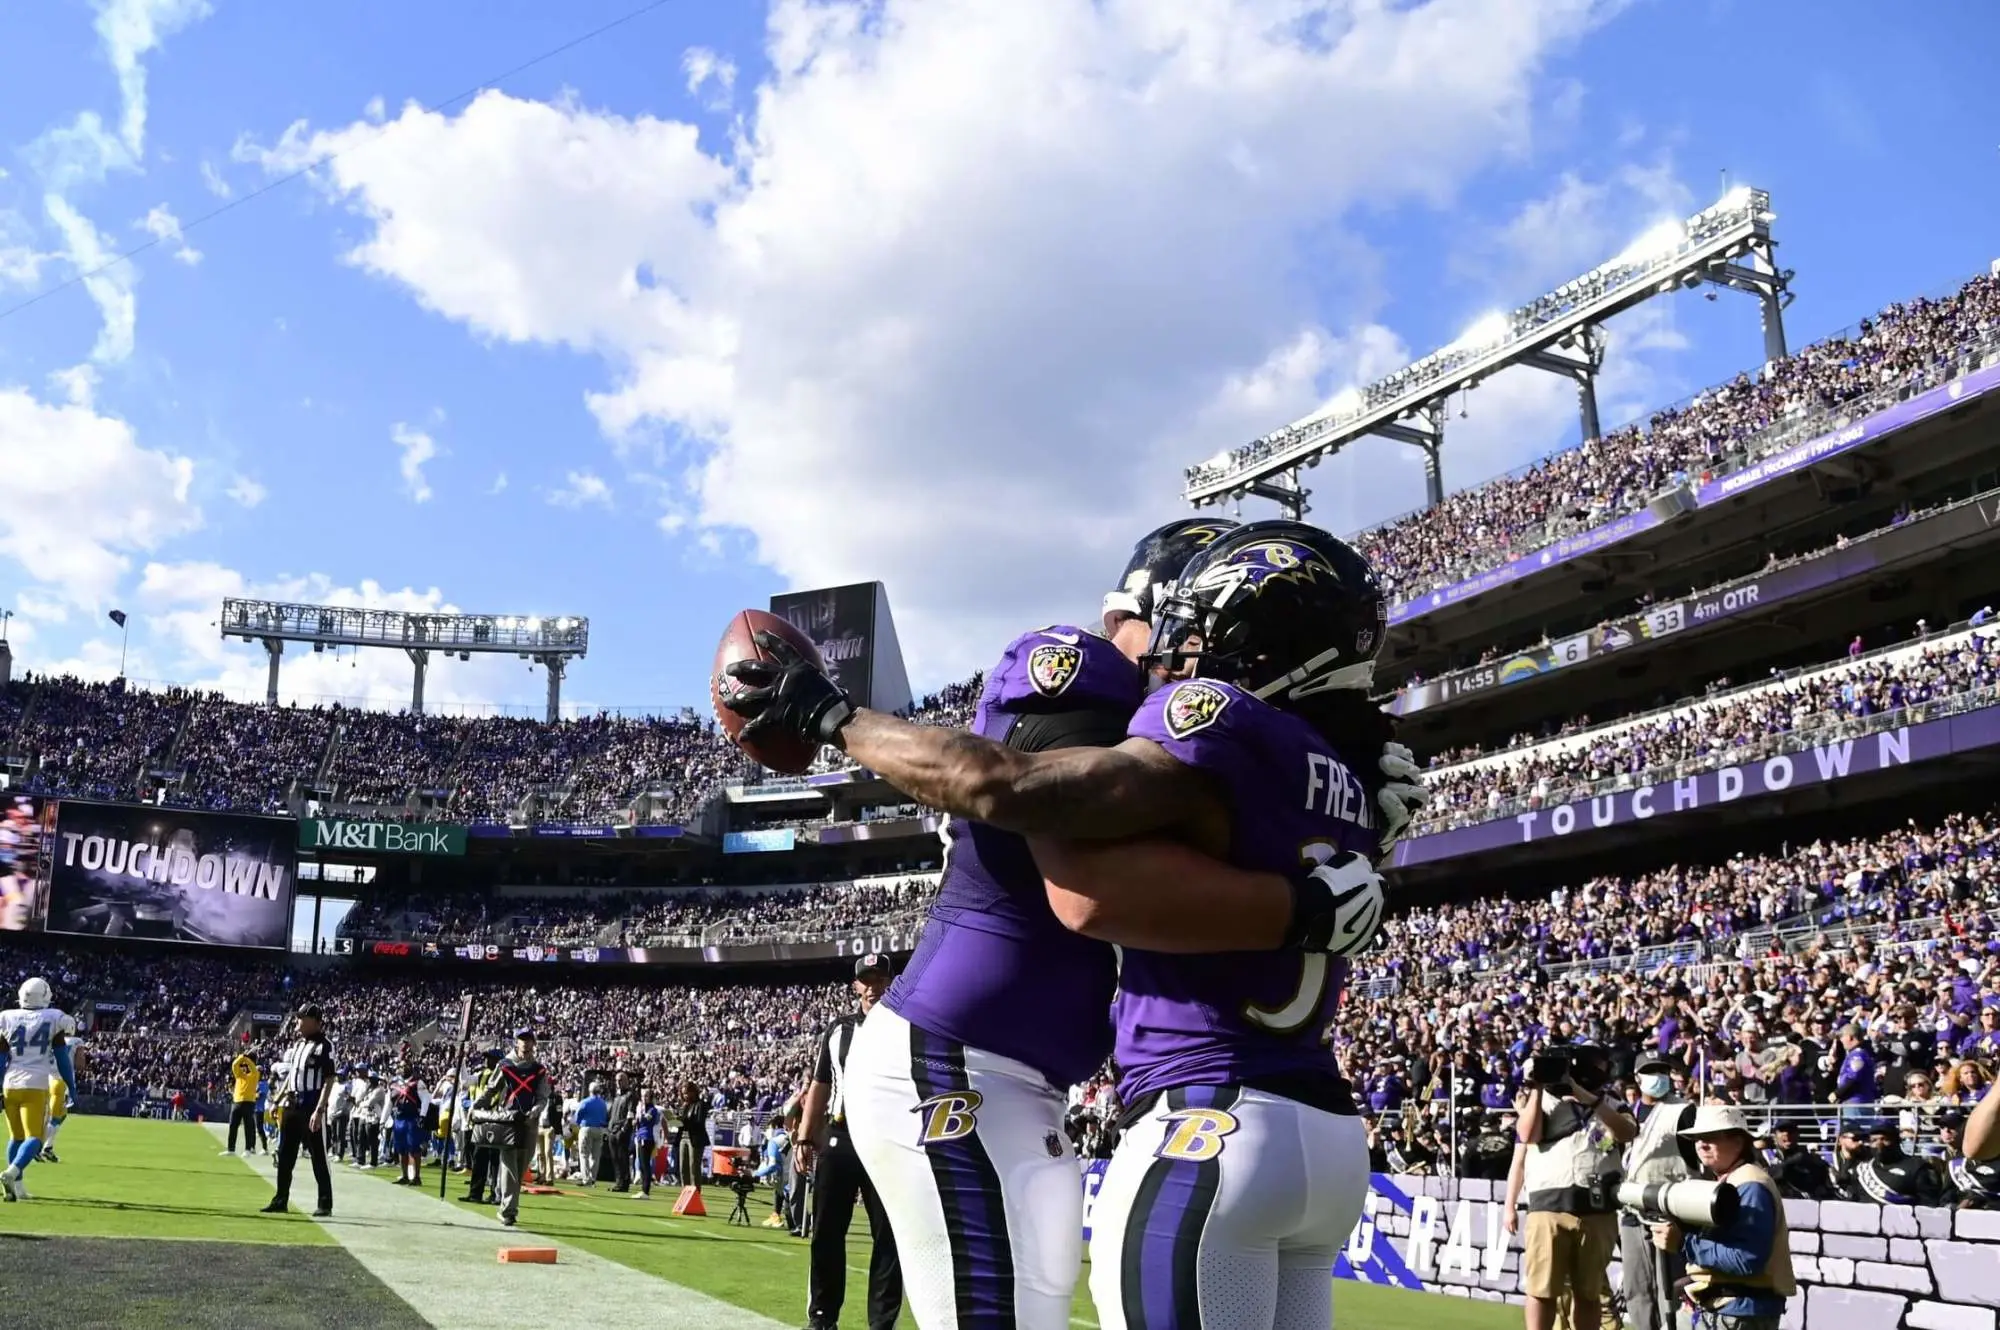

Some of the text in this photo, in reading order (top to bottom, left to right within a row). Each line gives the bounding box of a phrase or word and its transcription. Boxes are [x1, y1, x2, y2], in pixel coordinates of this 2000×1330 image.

[1454, 584, 1759, 694] 14:55 6 33 4TH QTR
[1516, 726, 1911, 842] TOUCHDOWN
[314, 820, 449, 853] M&T Bank
[62, 831, 284, 901] TOUCHDOWN
[95, 1002, 126, 1012] GEICO
[252, 1012, 283, 1022] GEICO
[9, 1021, 52, 1056] 44
